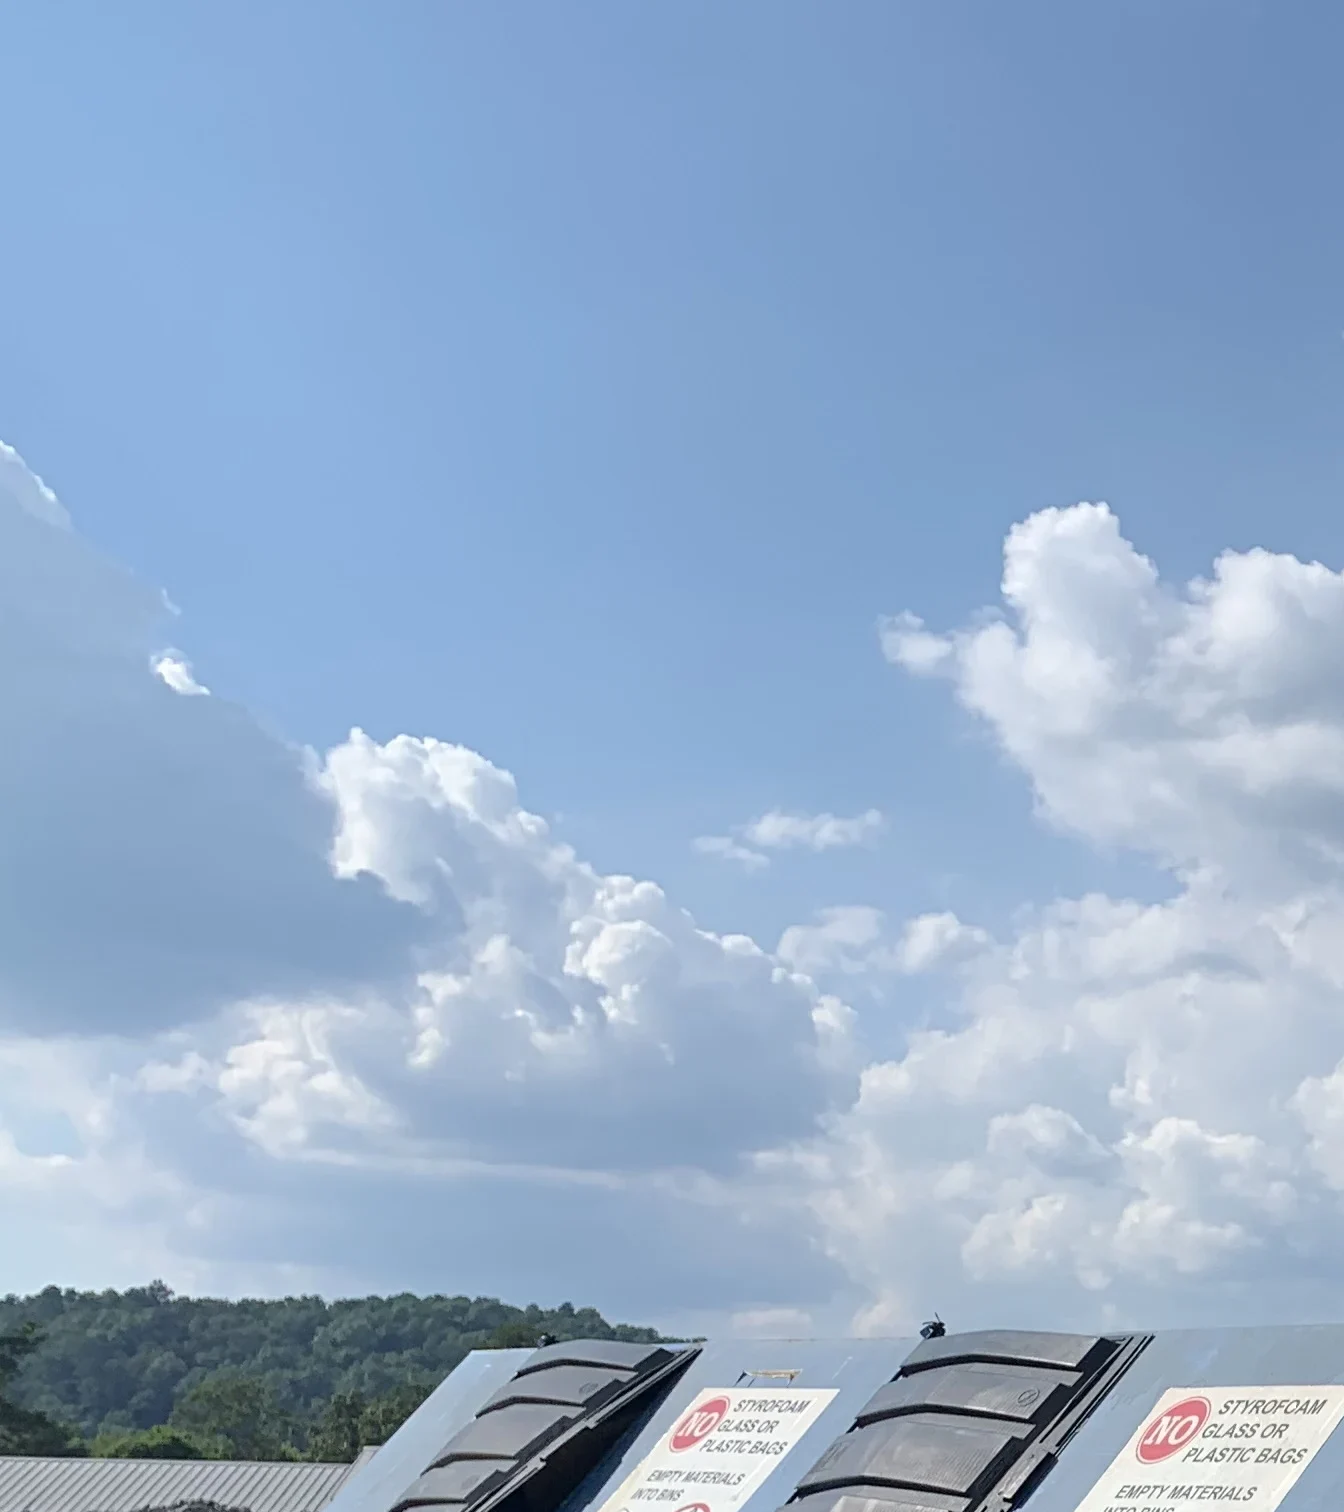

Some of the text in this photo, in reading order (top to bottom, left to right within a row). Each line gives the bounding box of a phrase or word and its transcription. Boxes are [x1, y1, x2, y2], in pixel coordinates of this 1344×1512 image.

[733, 1399, 811, 1413] STYROFOAM
[1218, 1399, 1328, 1416] STYROFOAM
[677, 1411, 719, 1437] NO
[717, 1419, 780, 1434] GLASS OR
[1143, 1415, 1199, 1447] NO
[1201, 1423, 1290, 1439] GLASS OR
[699, 1440, 788, 1456] PLASTIC BAGS
[1181, 1447, 1308, 1465] PLASTIC BAGS
[647, 1470, 746, 1486] EMPTY MATERIALS
[630, 1488, 684, 1501] INTO BINS
[1114, 1485, 1258, 1502] EMPTY MATERIALS
